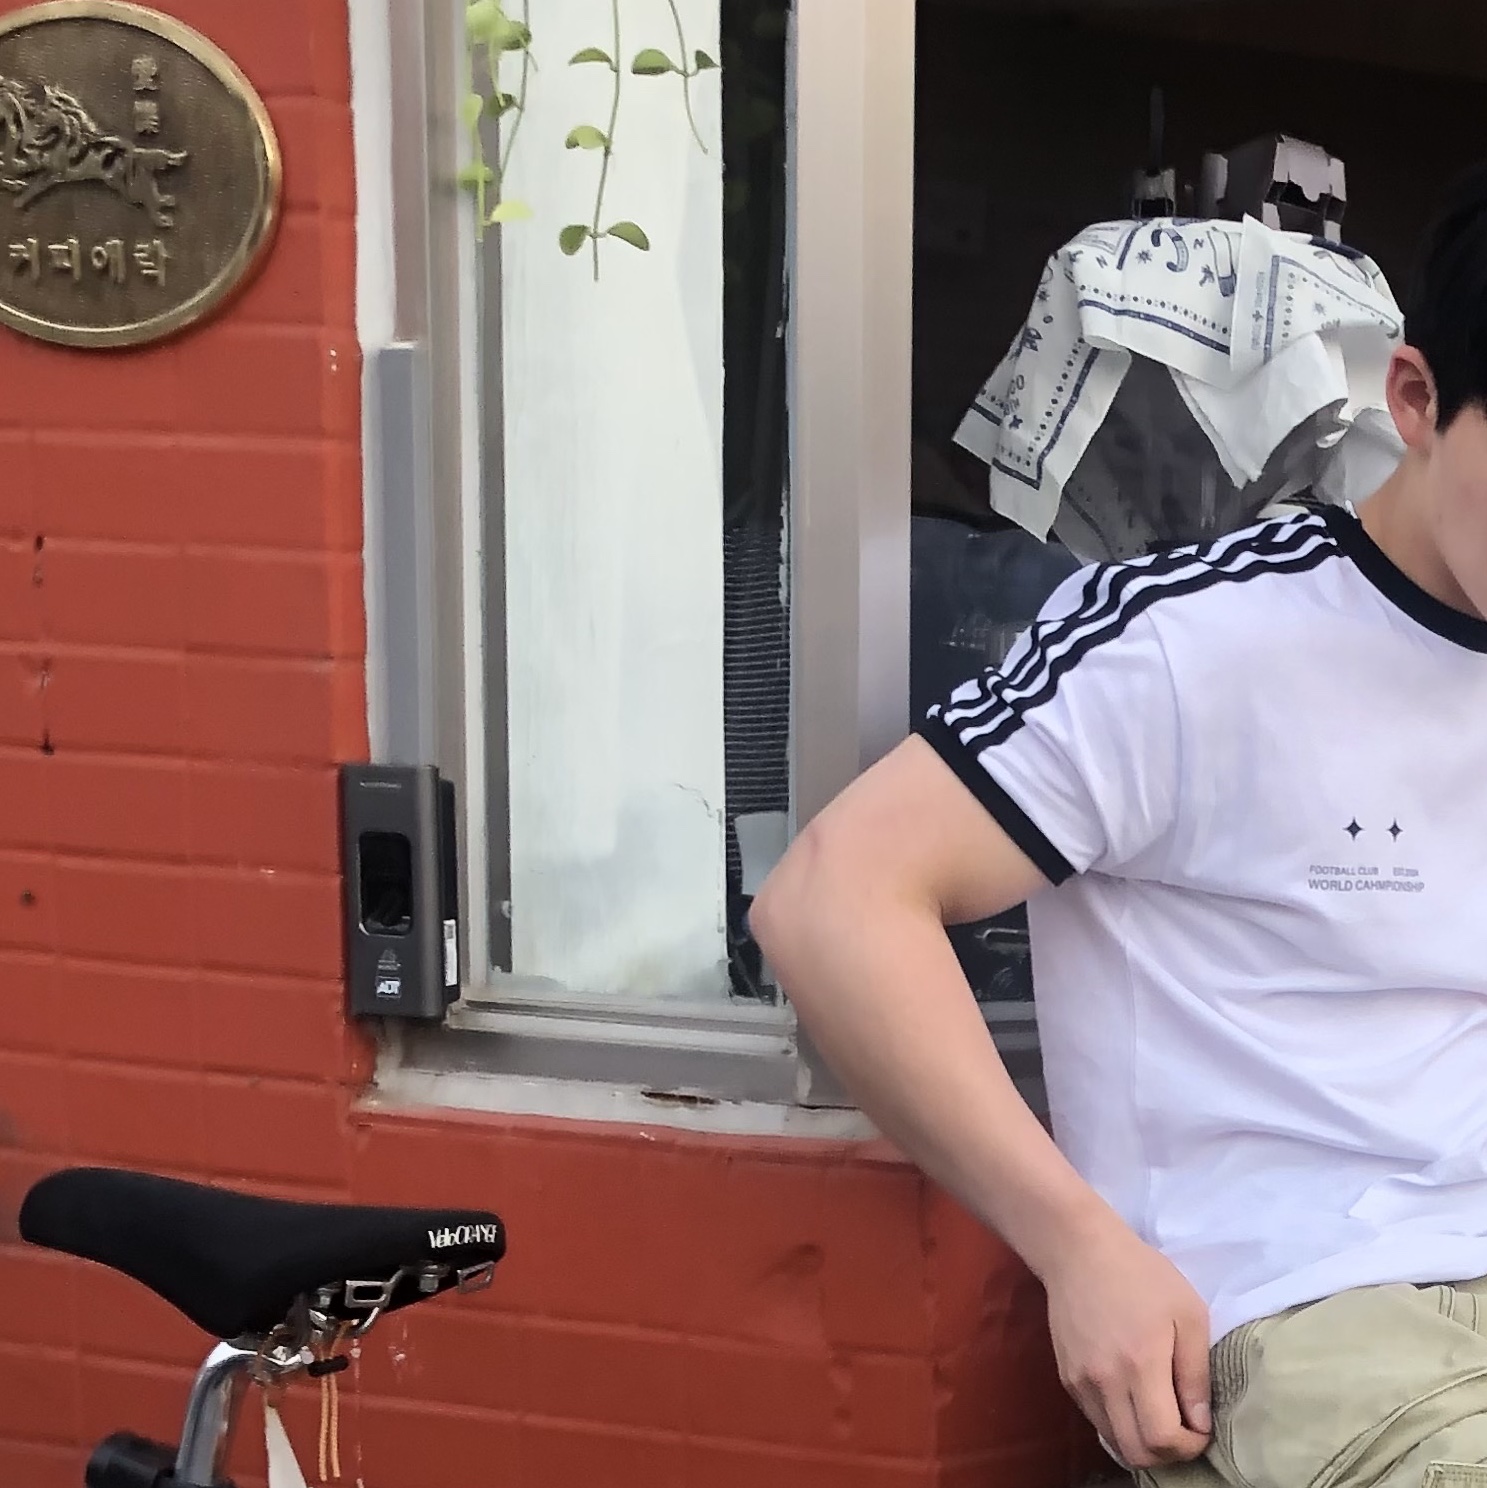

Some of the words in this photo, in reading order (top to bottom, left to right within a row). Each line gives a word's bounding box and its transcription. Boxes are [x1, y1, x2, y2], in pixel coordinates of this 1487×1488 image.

[8, 238, 169, 287] 커피애락
[1309, 865, 1356, 876] FOOTBALL
[1357, 867, 1379, 876] CLUB
[1308, 879, 1353, 892] WORLD
